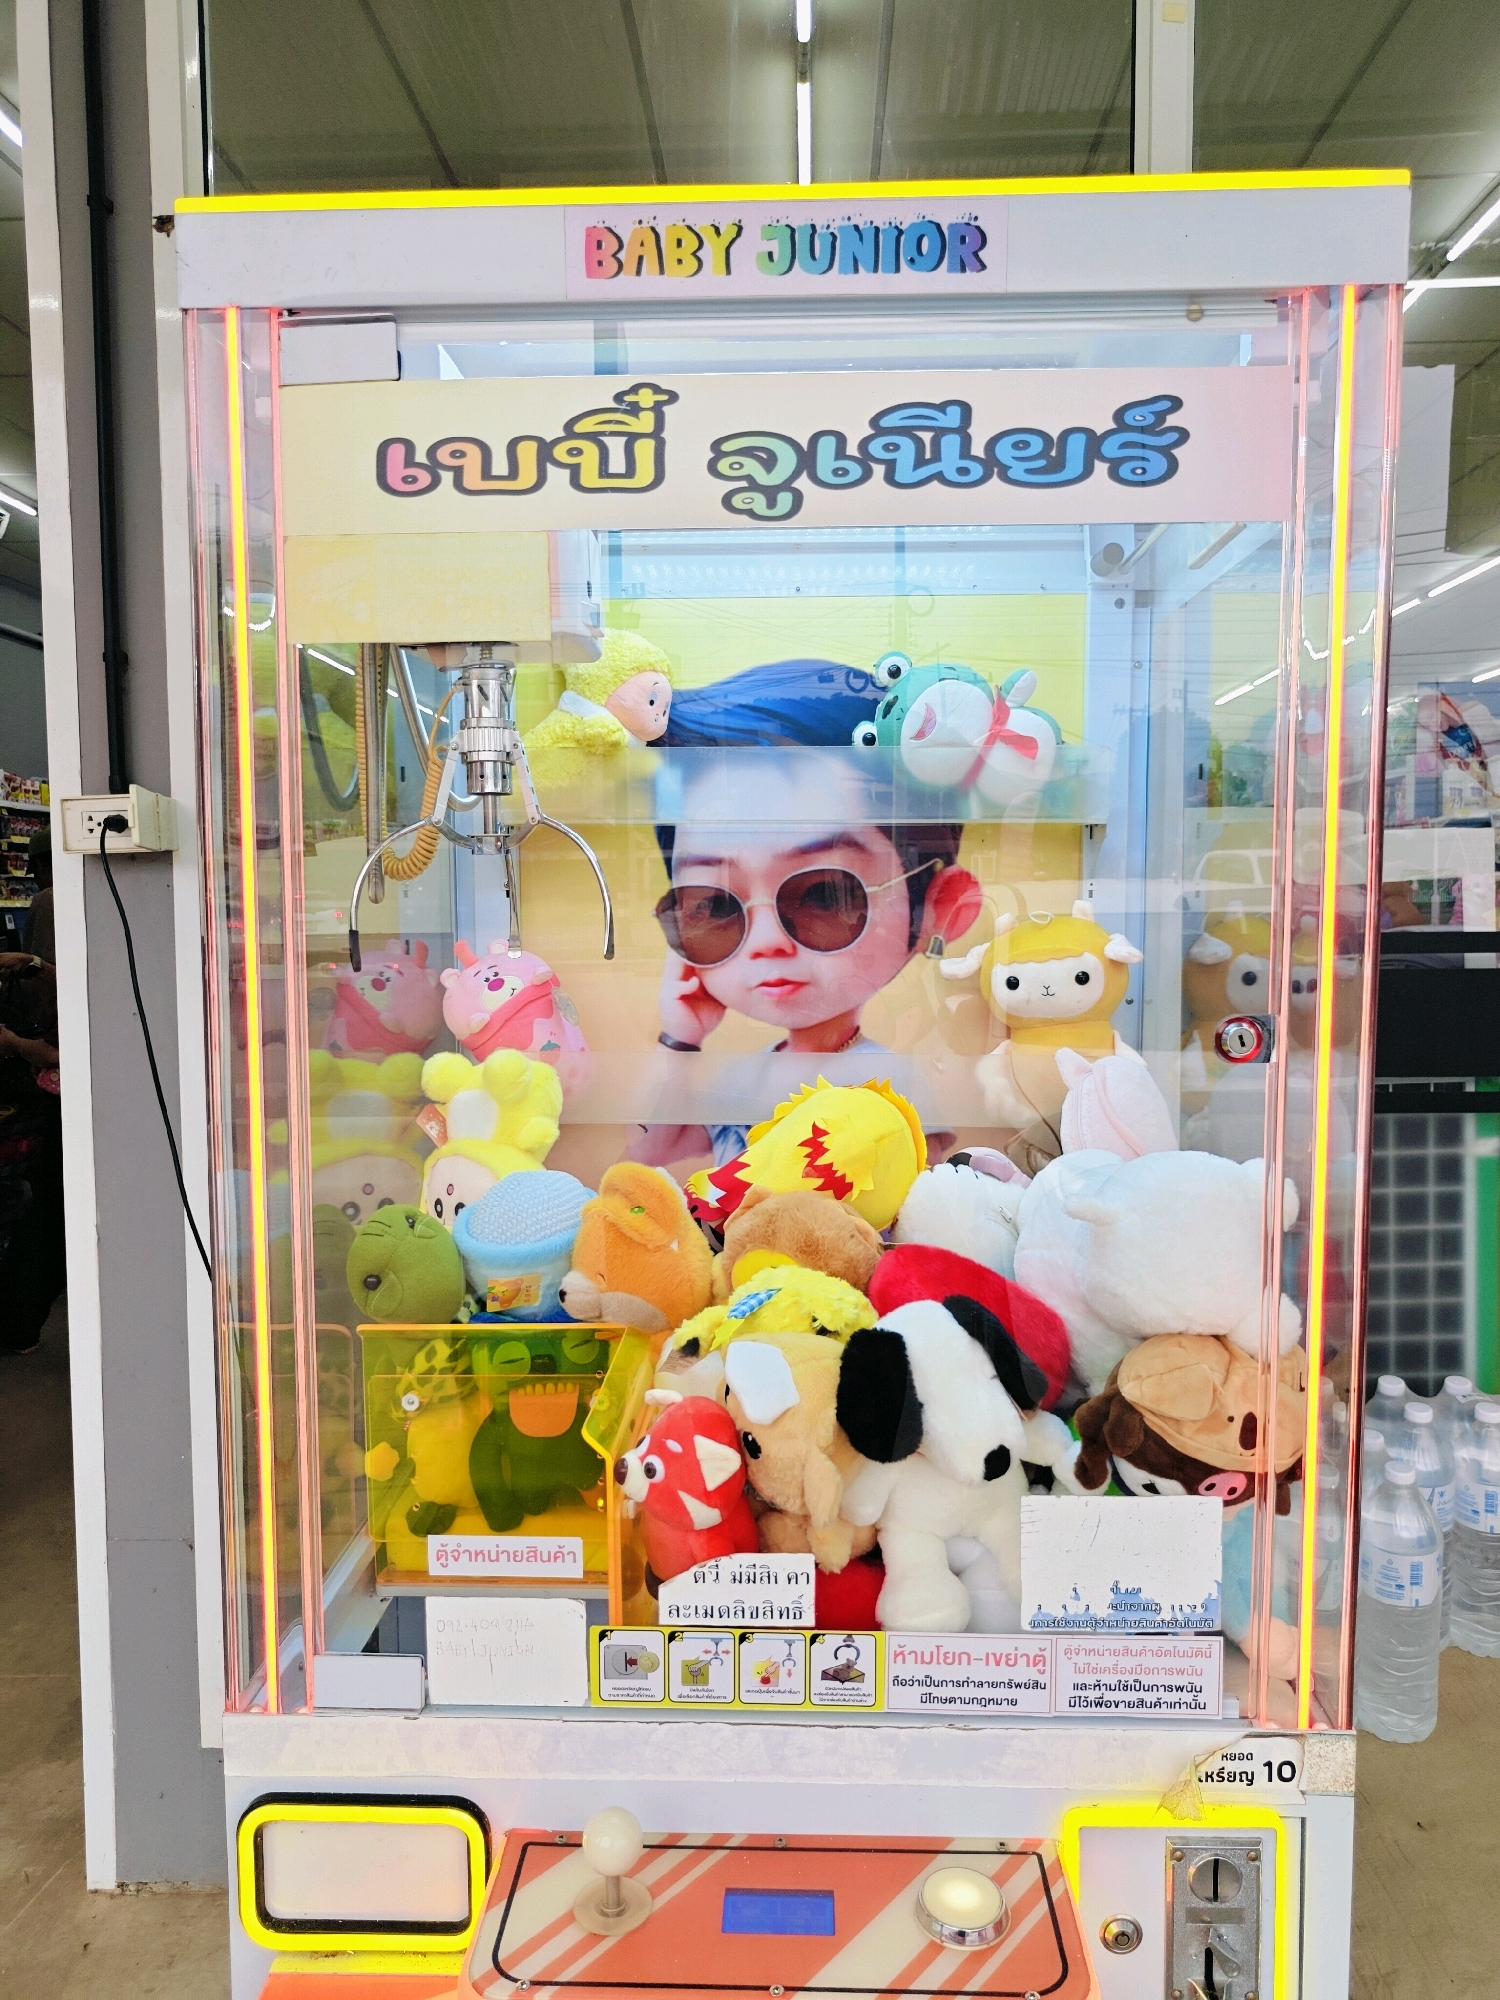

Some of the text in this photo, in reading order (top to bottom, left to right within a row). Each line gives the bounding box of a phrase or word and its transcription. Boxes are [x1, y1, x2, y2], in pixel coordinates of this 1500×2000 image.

[585, 214, 988, 280] BABY JUNIOR
[376, 382, 1190, 521] เบบี๋ จูเนียร์
[436, 1543, 577, 1568] ตู้จำหน่ายสินค้า
[605, 1630, 612, 1641] 1
[674, 1632, 683, 1642] 2
[745, 1634, 754, 1643] 3
[816, 1635, 825, 1645] 4
[893, 1644, 1047, 1675] ห้ามโยก-เขย่าตู้
[1064, 1644, 1213, 1660] ตู้จำหน่ายสินค้าอัตโนมัตินี้
[1073, 1660, 1203, 1676] ไม่ใช่เครื่องมือการพนัน
[892, 1675, 1047, 1690] ถือว่าเป็นการทำลายทรัพย์สิน
[1072, 1679, 1202, 1693] และห้ามใช้เป็นการพนัน
[1068, 1695, 1206, 1710] มีไว้เพื่อขายสินค้าเท่านั้น
[1221, 1752, 1254, 1761] หยอด
[1263, 1760, 1297, 1783] 10
